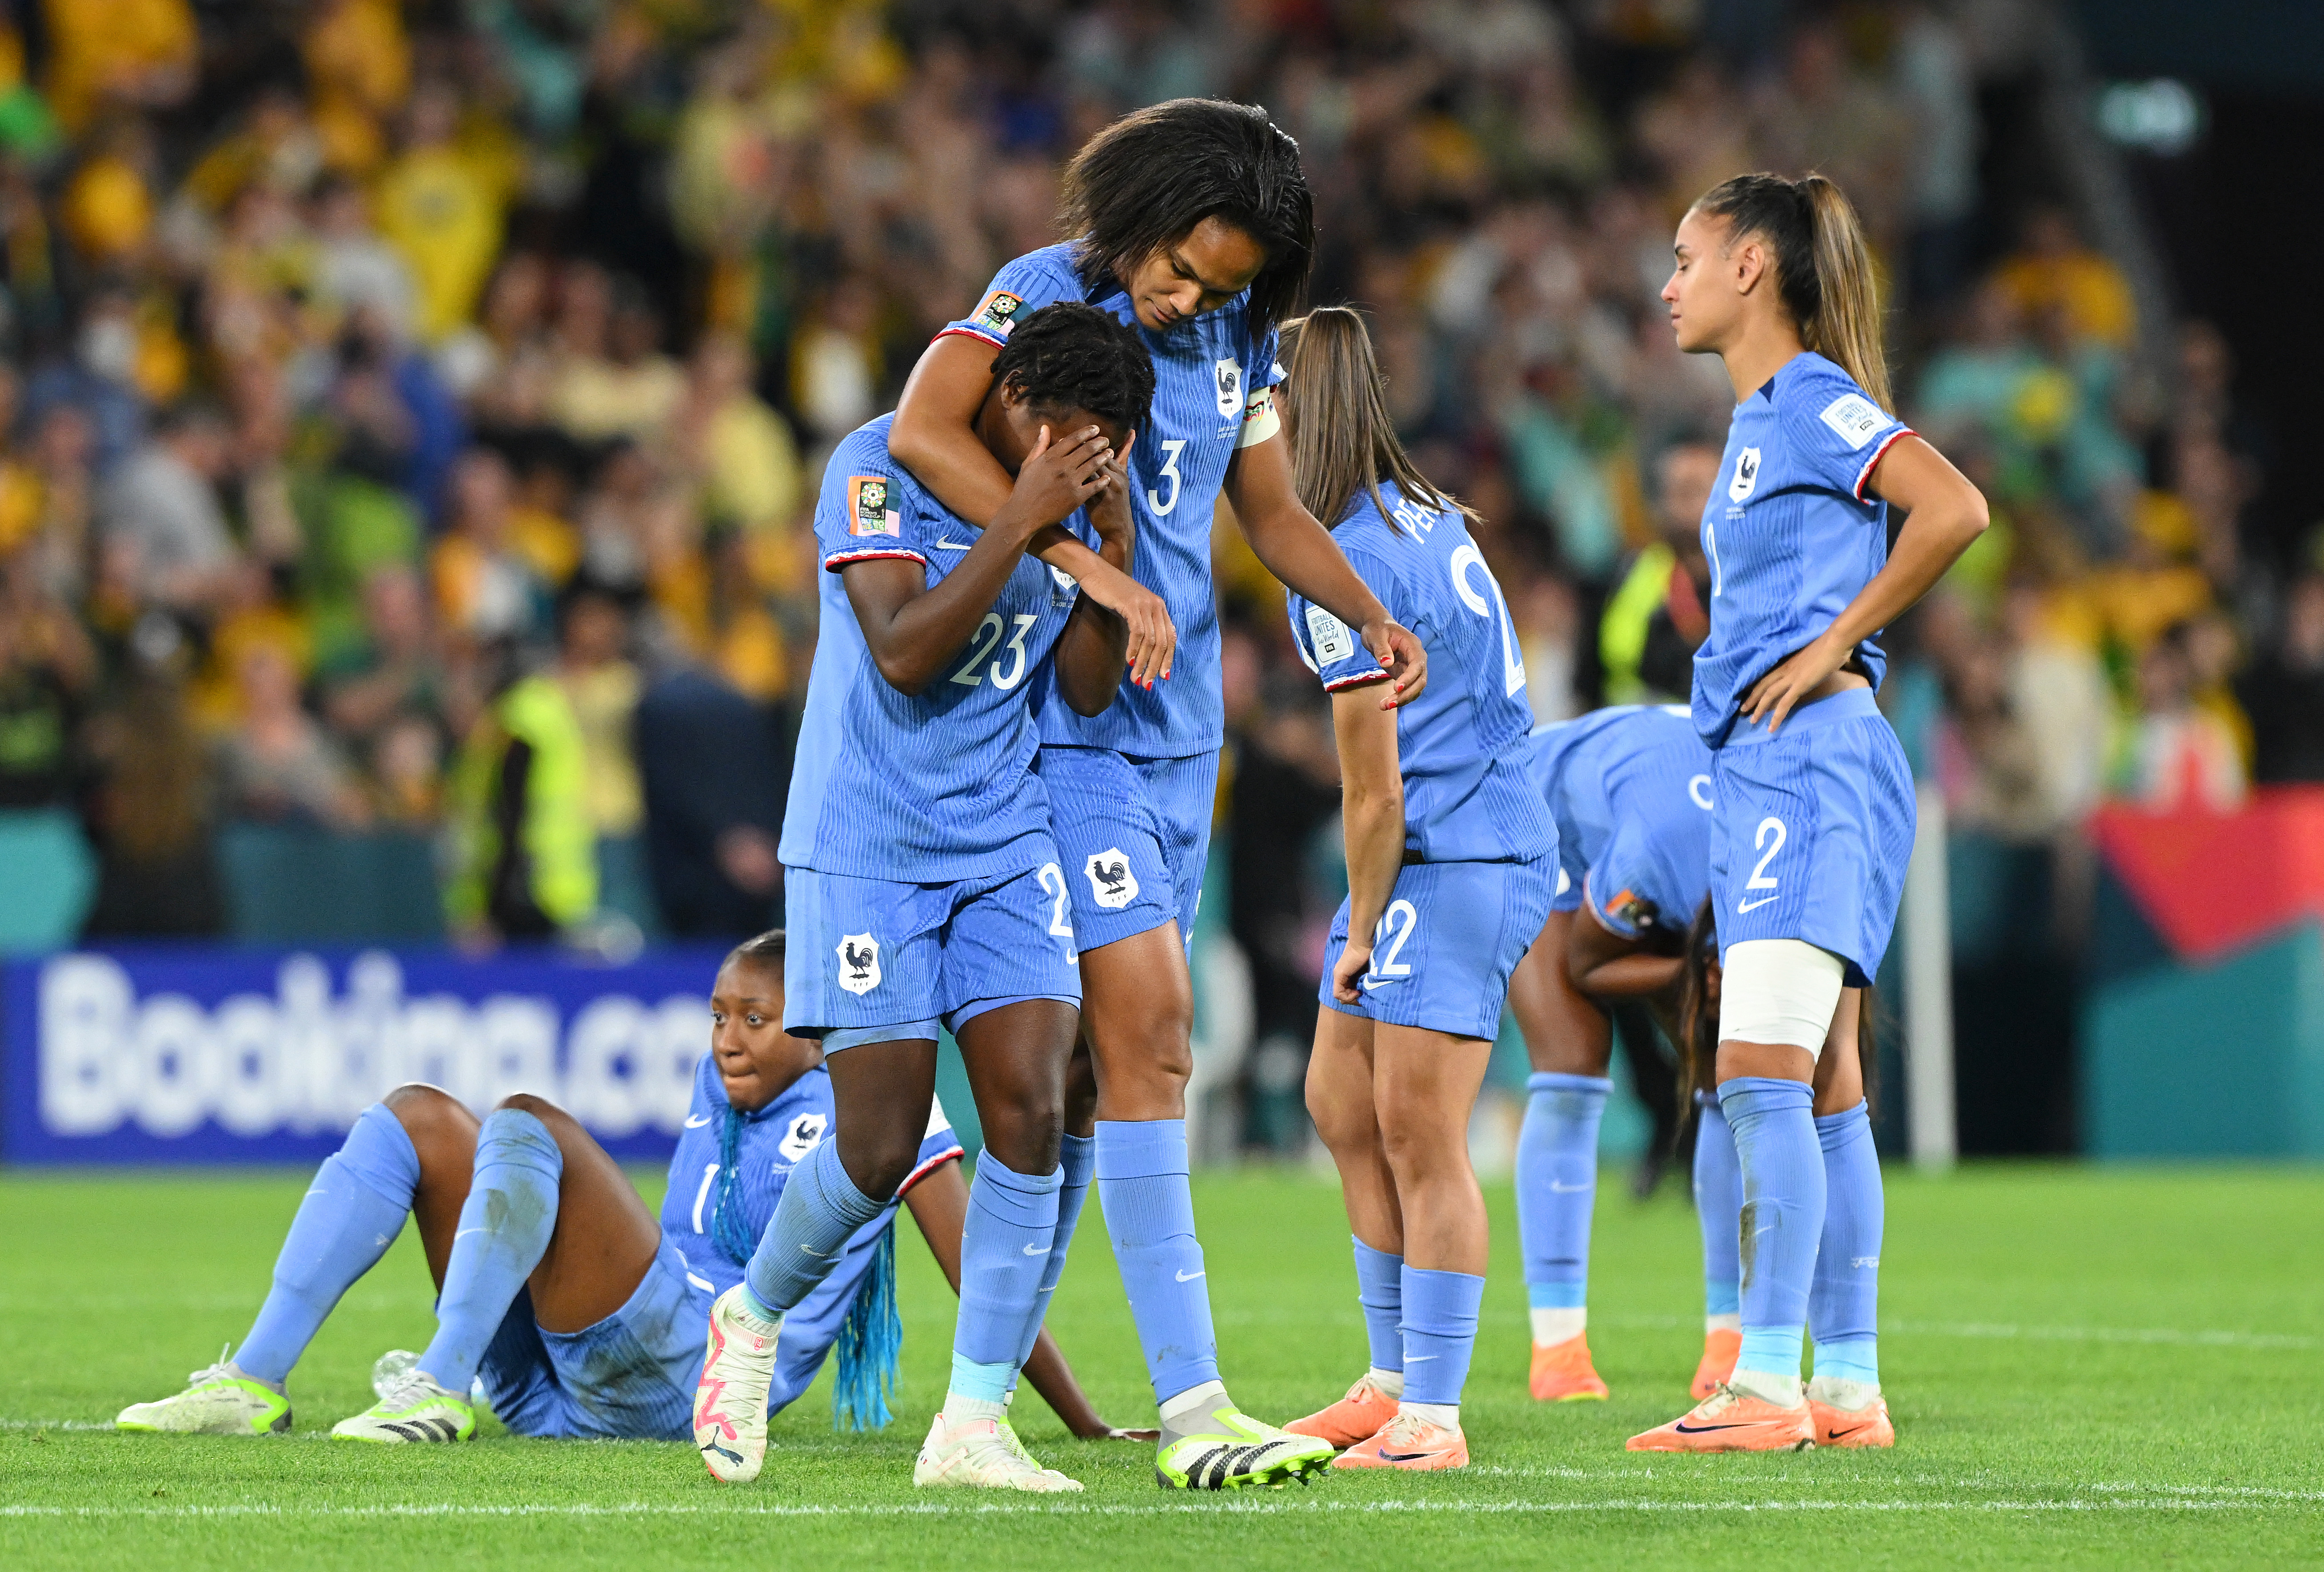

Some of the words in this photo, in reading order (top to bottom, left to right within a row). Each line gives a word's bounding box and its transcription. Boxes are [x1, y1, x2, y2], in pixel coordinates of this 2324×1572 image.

[1148, 440, 1187, 516] 3
[949, 612, 1038, 690] 23
[1311, 613, 1332, 626] FOOTBALL
[1314, 620, 1335, 636] UNITES
[1323, 630, 1339, 643] World
[1450, 533, 1526, 698] 2
[1746, 816, 1787, 889] 2
[1038, 862, 1073, 938] 2
[692, 1163, 739, 1235] 1
